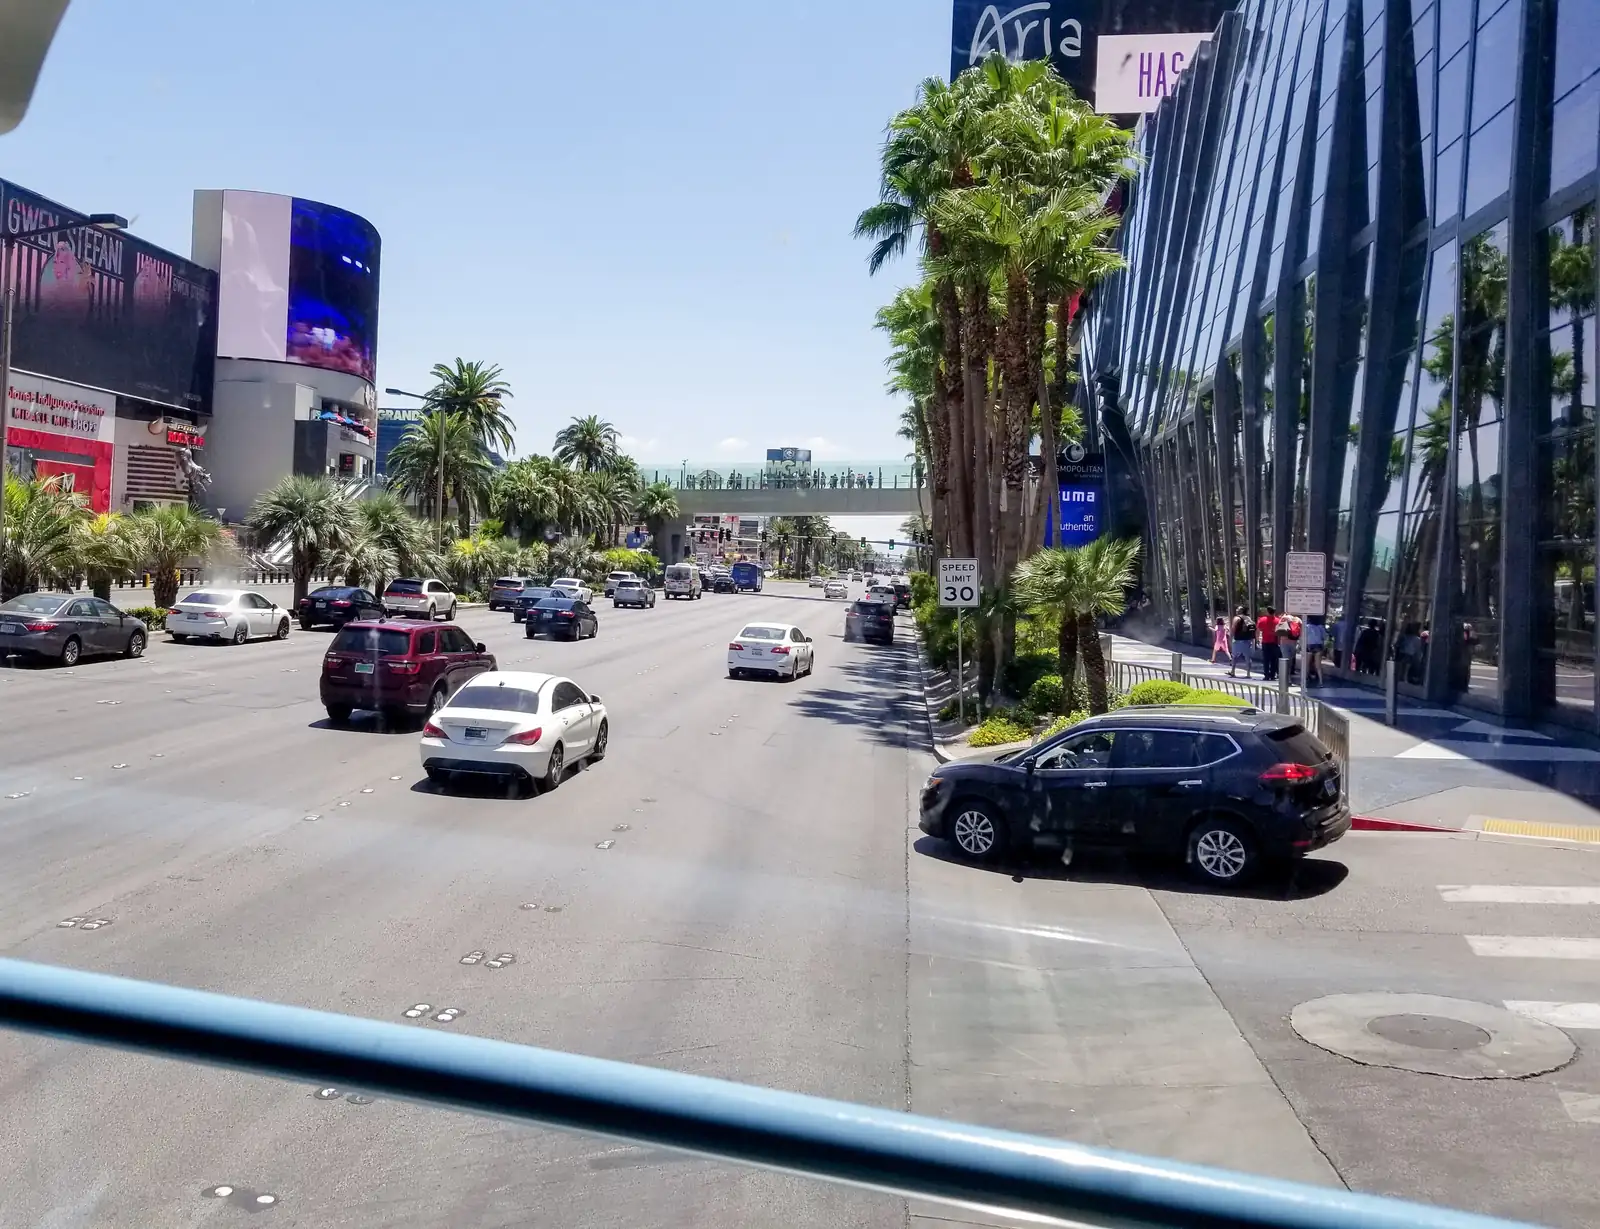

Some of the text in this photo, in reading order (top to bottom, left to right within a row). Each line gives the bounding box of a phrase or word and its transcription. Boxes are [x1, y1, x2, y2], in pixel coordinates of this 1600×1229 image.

[969, 2, 1081, 65] Aria
[8, 198, 124, 274] GWEN STEFANI
[12, 407, 49, 424] MIRACLE
[52, 414, 71, 428] MILE
[377, 409, 420, 421] GRAND
[1058, 490, 1095, 502] uma
[1083, 514, 1094, 522] an
[1060, 523, 1094, 532] uthentic
[944, 586, 974, 601] 30
